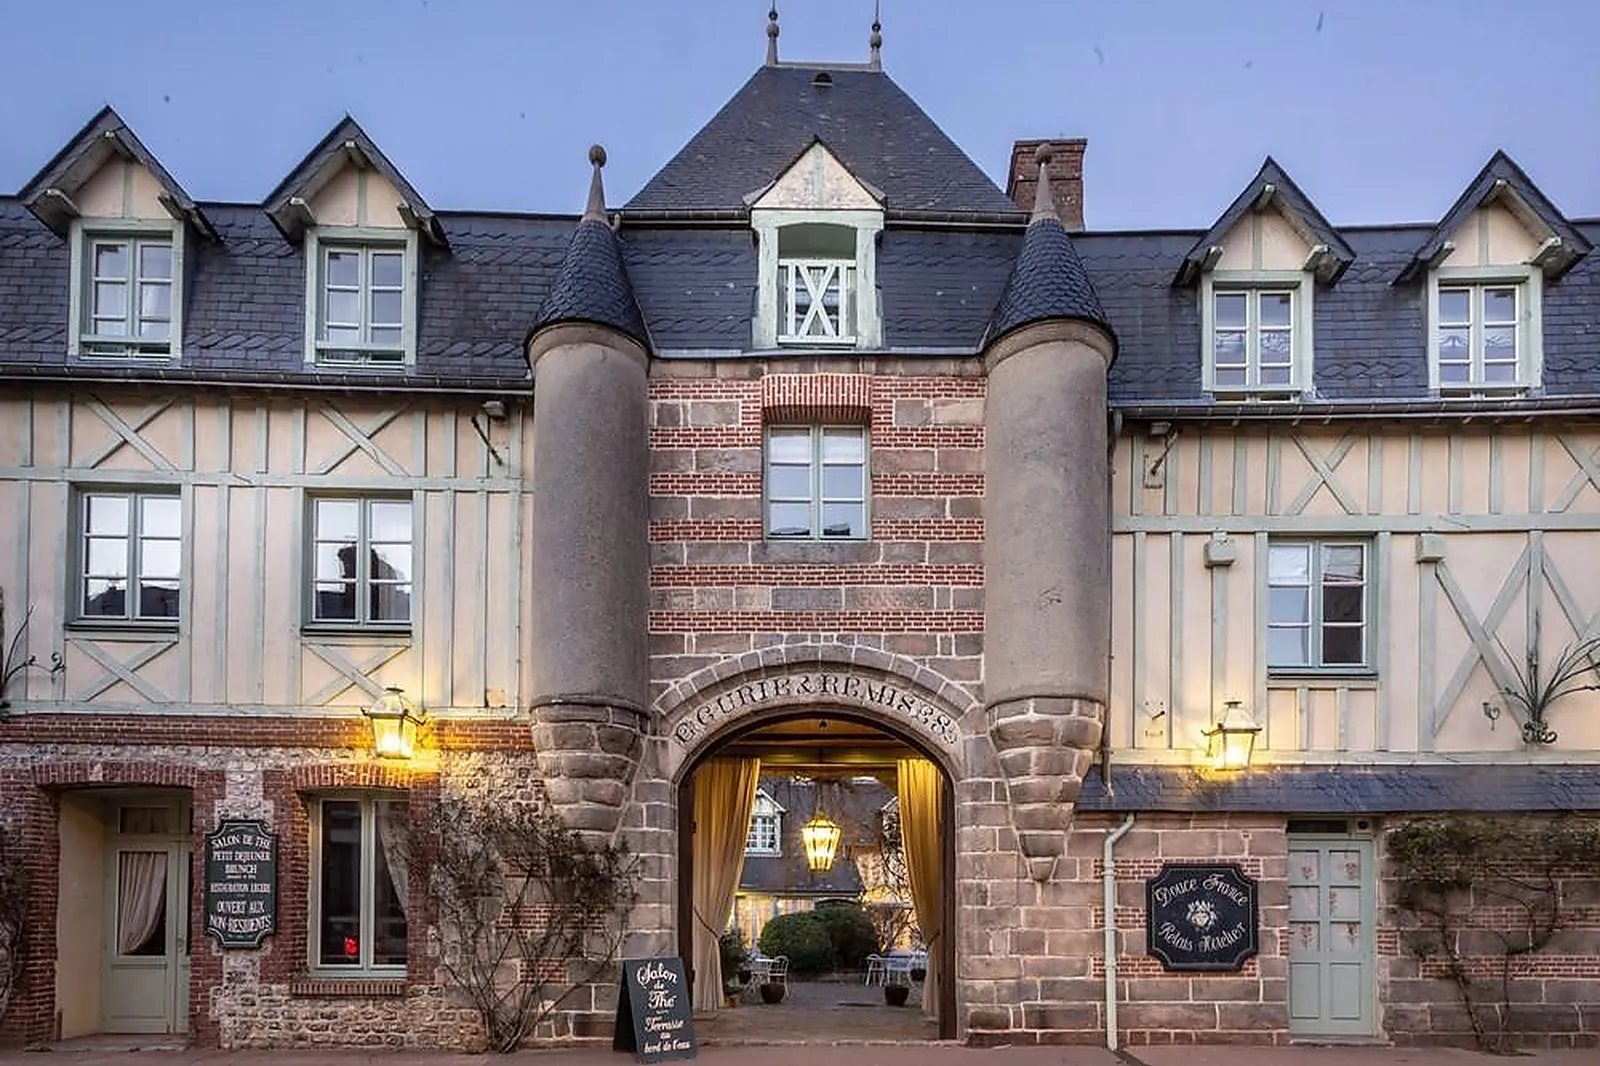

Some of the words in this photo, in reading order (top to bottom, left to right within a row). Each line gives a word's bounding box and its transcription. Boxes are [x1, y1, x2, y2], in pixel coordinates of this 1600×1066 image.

[212, 835, 240, 849] SALON
[243, 835, 253, 845] DE
[213, 851, 233, 861] PETIT
[225, 864, 257, 874] BRUNCH
[1154, 879, 1197, 907] Douce
[1203, 873, 1248, 907] France
[217, 901, 246, 914] OUVERT
[249, 901, 265, 914] AUX
[637, 962, 678, 988] Salon
